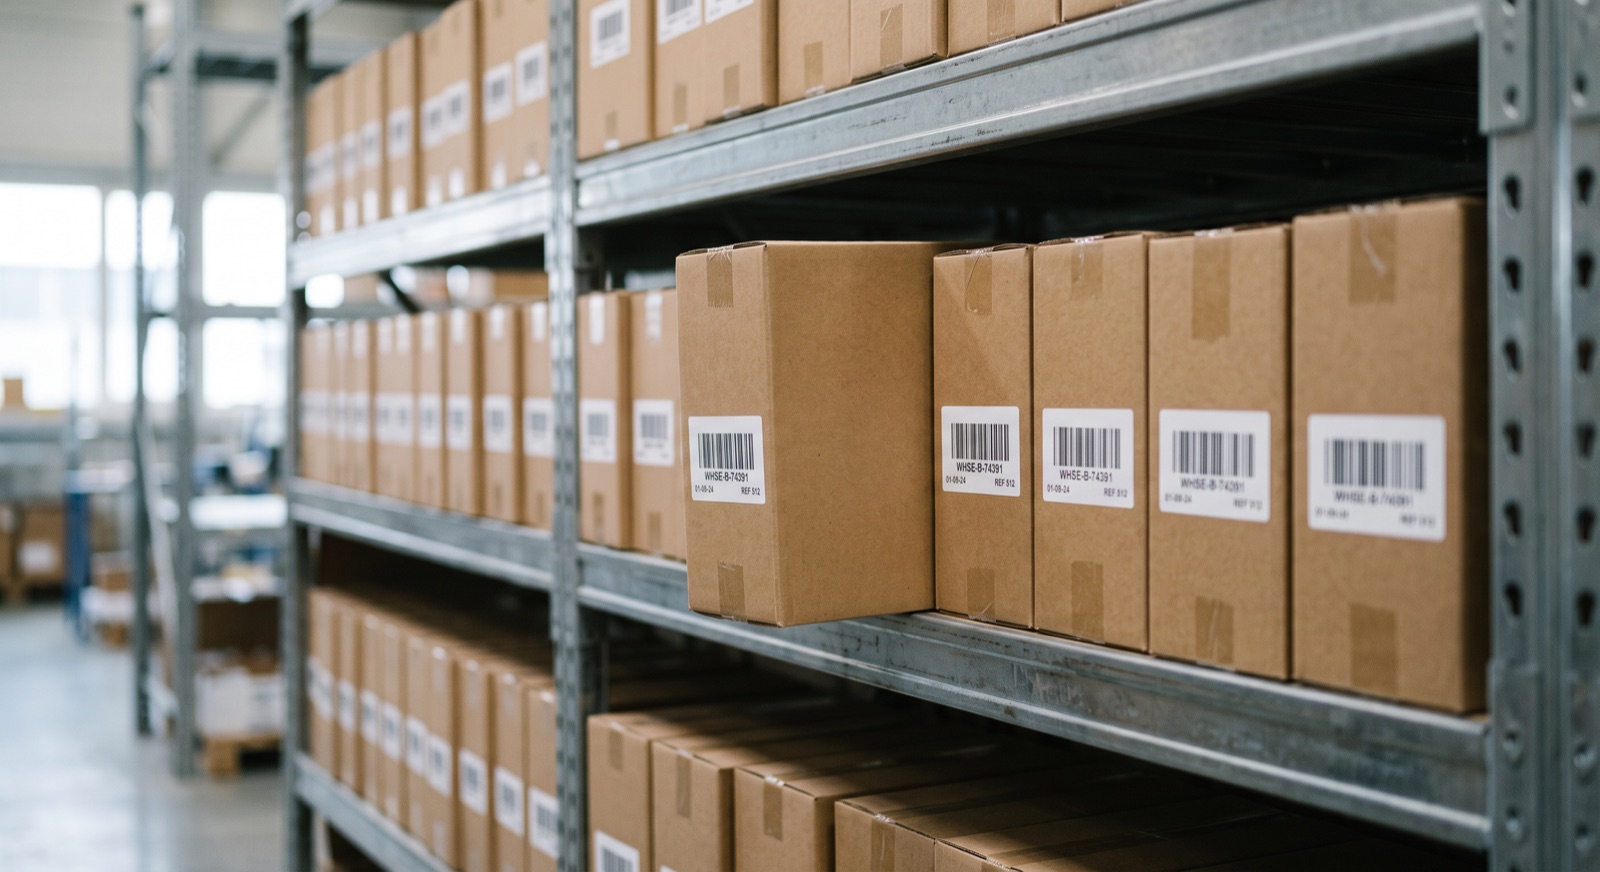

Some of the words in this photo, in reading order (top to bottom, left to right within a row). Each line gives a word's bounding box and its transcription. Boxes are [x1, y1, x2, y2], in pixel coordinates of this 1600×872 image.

[957, 462, 1003, 474] WHSE-B-74391
[705, 471, 749, 482] WHSE-B-74391
[1059, 470, 1113, 482] WHSE-B-74391
[995, 478, 1005, 487] REF
[1006, 479, 1015, 487] 512
[741, 486, 751, 495] REF
[752, 487, 760, 496] 512
[1104, 488, 1115, 497] REF
